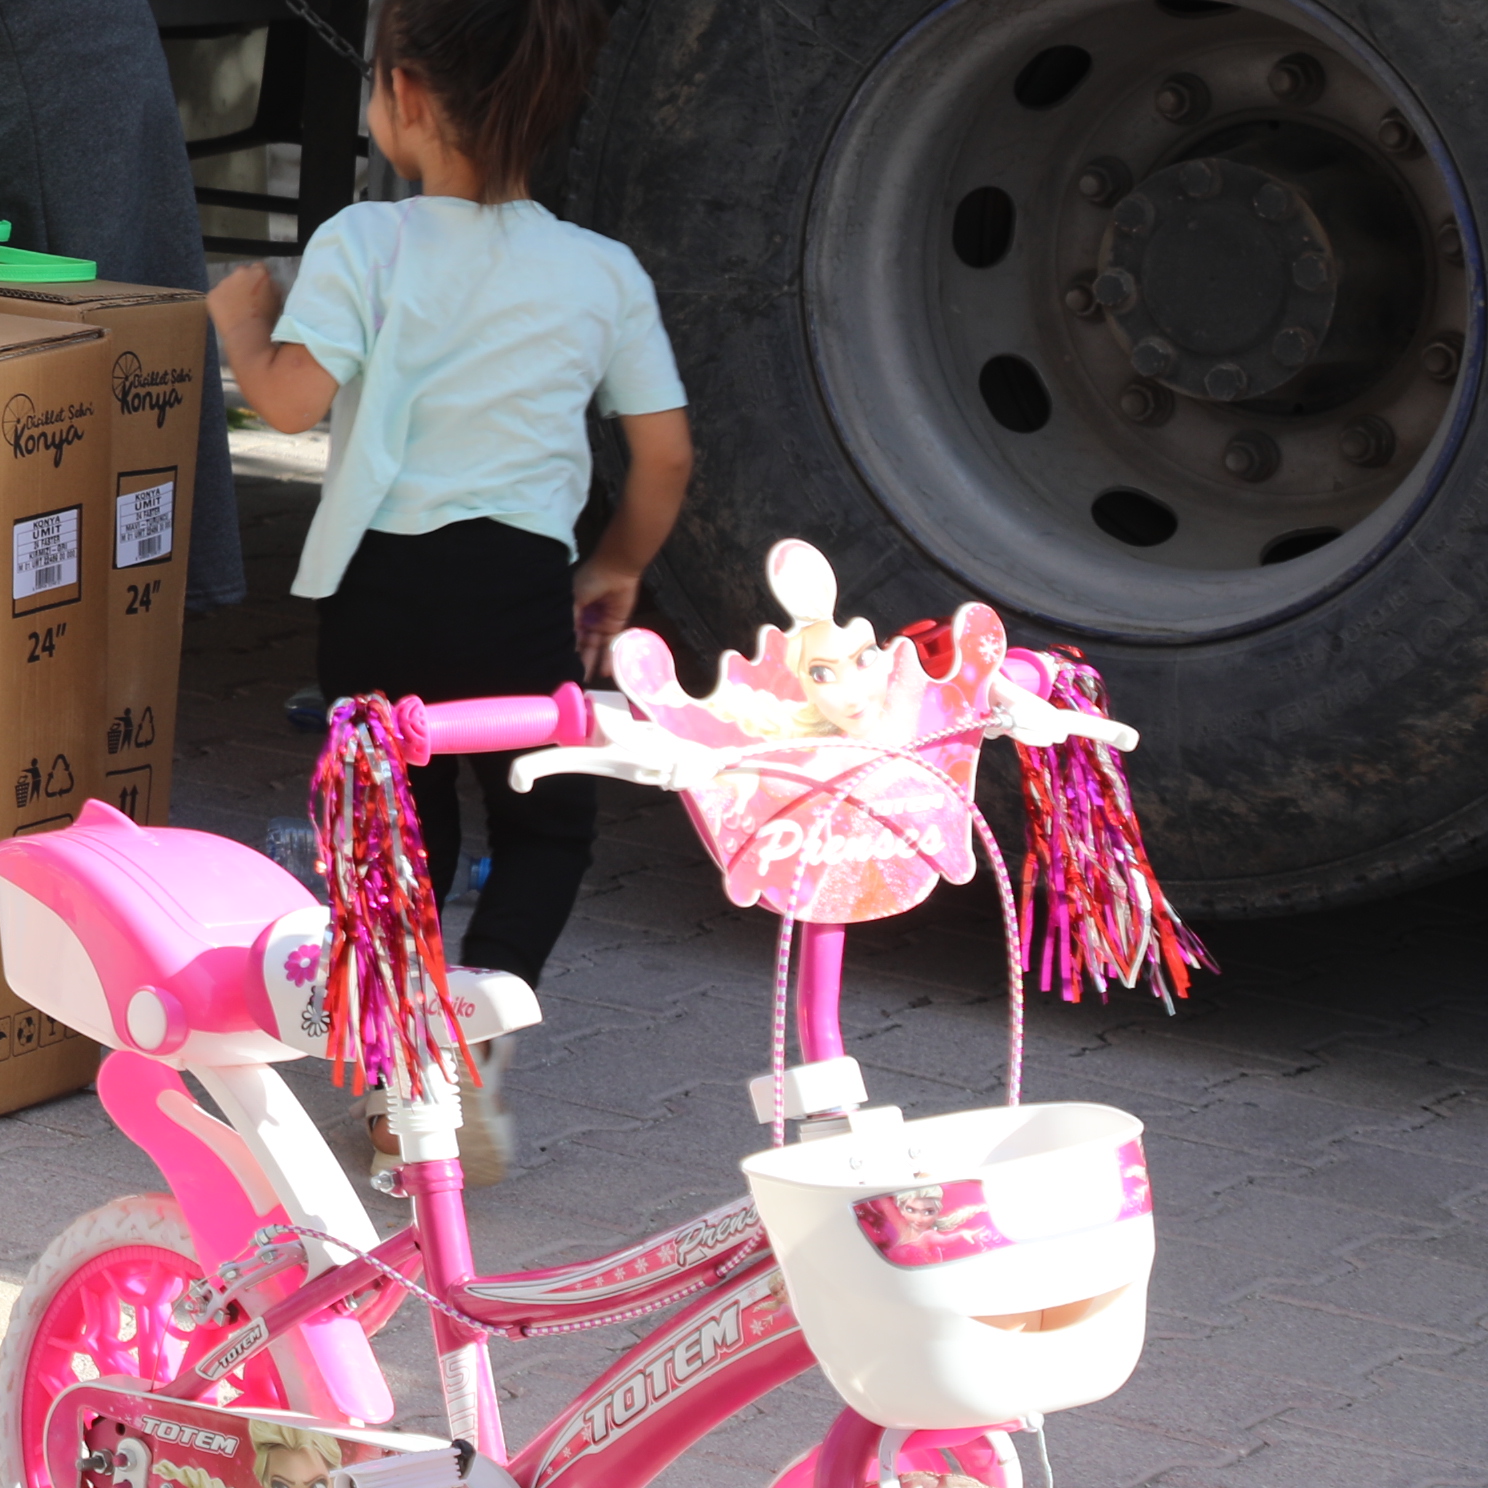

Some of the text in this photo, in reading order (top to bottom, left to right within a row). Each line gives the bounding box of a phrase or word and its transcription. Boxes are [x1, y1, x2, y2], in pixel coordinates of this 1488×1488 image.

[120, 379, 183, 429] Konya
[13, 421, 85, 468] Konya
[33, 515, 61, 530] KONYA
[426, 996, 476, 1019] Ciko
[218, 1324, 263, 1369] TOTEM
[583, 1298, 744, 1447] TOTEM
[140, 1414, 241, 1459] TOTEM
